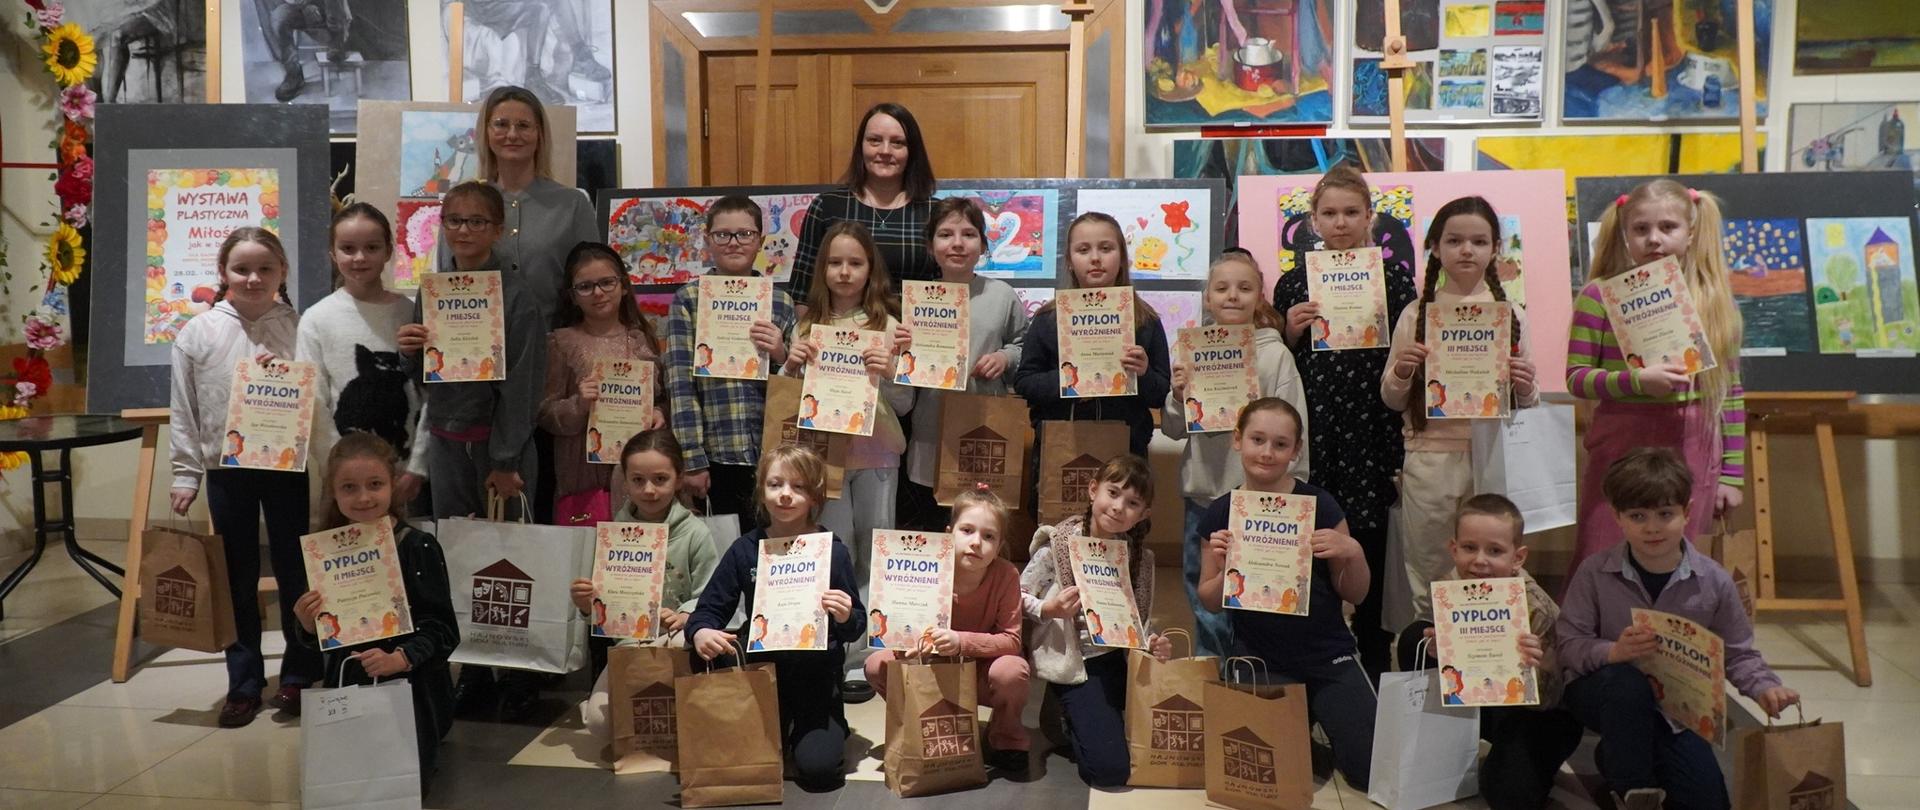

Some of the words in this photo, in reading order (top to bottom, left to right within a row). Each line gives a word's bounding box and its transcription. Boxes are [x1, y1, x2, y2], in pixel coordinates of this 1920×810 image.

[177, 192, 248, 205] WYSTAWA
[177, 210, 248, 220] PLASTYCZNA
[1322, 272, 1370, 283] DYPLOM
[438, 298, 488, 310] DYPLOM
[712, 300, 758, 311] DYPLOM
[1621, 287, 1672, 315] DYPLOM
[914, 306, 957, 319] DYPLOM
[912, 319, 959, 329] WYRÓŻNIENIE
[1072, 314, 1120, 325] DYPLOM
[1071, 327, 1122, 336] WYRÓŻNIENIE
[1441, 329, 1494, 341] DYPLOM
[1194, 349, 1242, 362] DYPLOM
[247, 384, 299, 399] DYPLOM
[601, 383, 641, 395] DYPLOM
[1245, 519, 1298, 535] DYPLOM
[1242, 534, 1299, 547] WYRÓŻNIENIE
[324, 549, 381, 572] DYPLOM
[608, 550, 653, 562] DYPLOM
[605, 564, 653, 574] WYRÓŻNIENIE
[770, 561, 816, 576] DYPLOM
[887, 559, 939, 573] DYPLOM
[1082, 564, 1119, 577] DYPLOM
[341, 565, 376, 580] MIEJSCE
[884, 573, 939, 584] WYRÓŻNIENIE
[767, 575, 816, 587] WYRÓŻNIENIE
[1452, 608, 1511, 623] DYPLOM
[1469, 625, 1505, 634] MIEJSCE
[1655, 634, 1711, 668] DYPLOM
